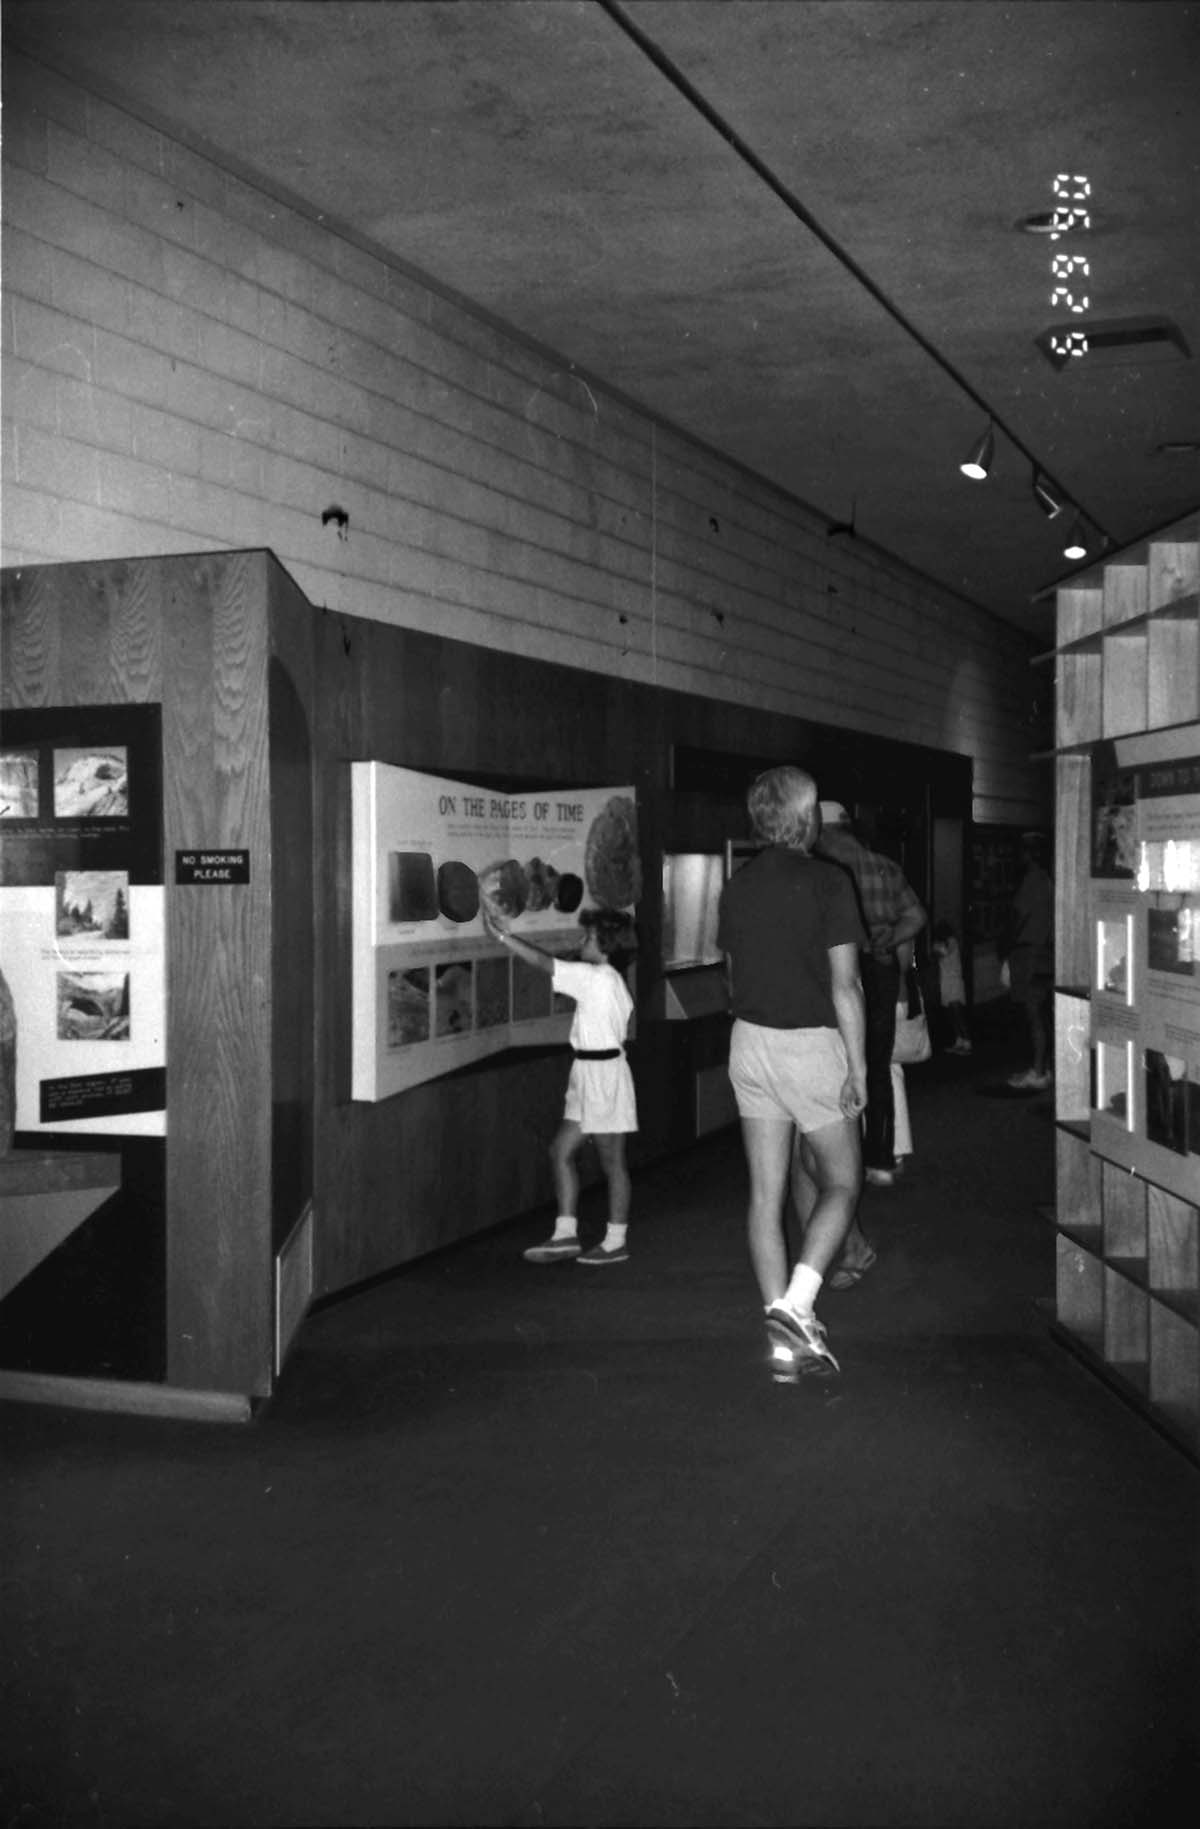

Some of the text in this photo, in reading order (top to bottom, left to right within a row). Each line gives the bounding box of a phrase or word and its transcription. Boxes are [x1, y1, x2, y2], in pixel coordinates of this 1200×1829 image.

[438, 795, 584, 822] ON THE PAGES OF TIME
[182, 855, 244, 865] NO SMOKING
[193, 869, 231, 879] PLEASE
